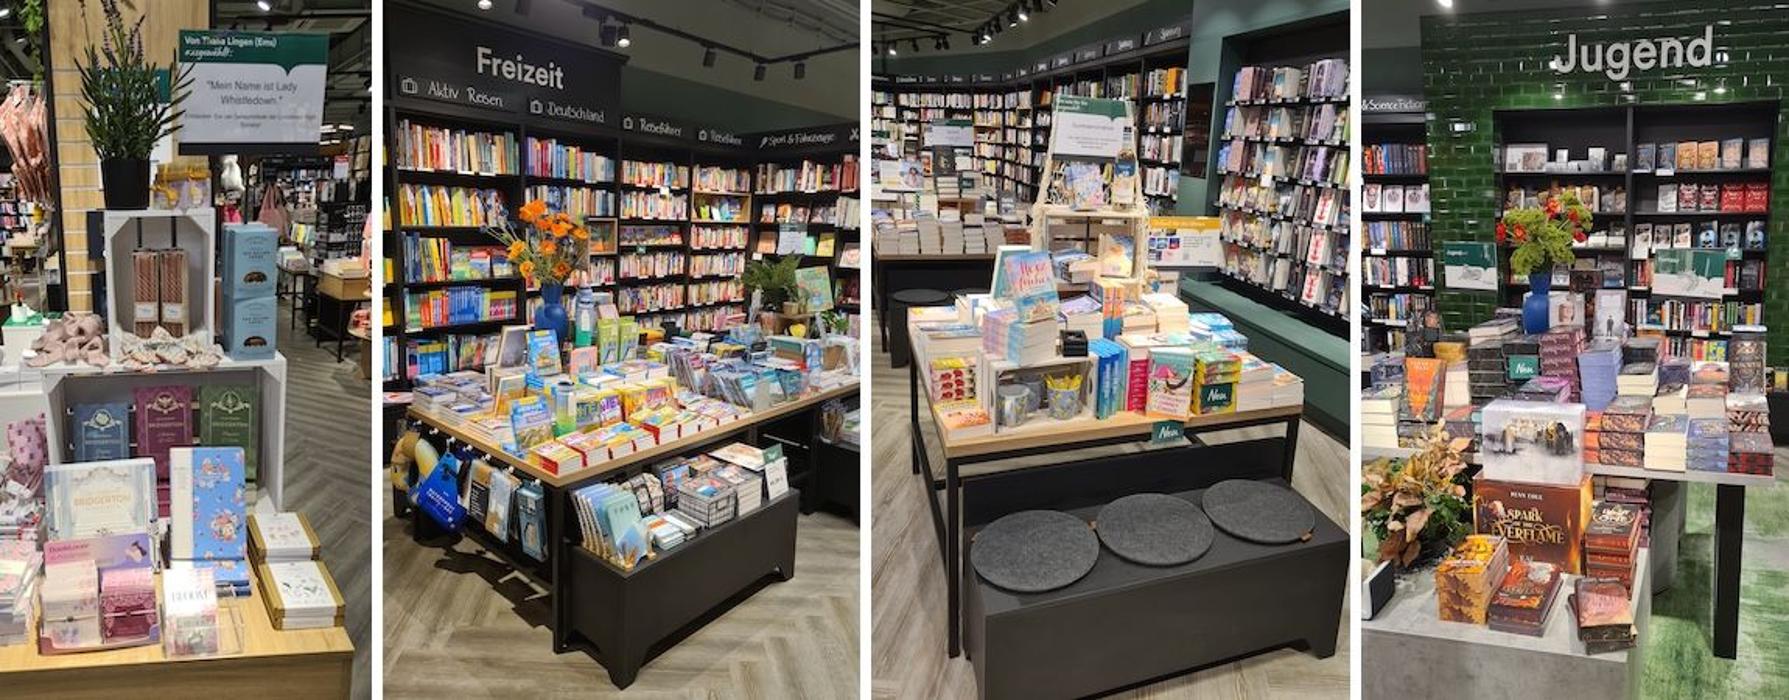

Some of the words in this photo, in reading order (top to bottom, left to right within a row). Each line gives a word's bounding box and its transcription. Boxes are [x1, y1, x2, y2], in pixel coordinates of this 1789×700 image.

[1554, 24, 1714, 81] Jugend
[476, 46, 564, 89] Freizeit
[234, 81, 262, 92] Name
[263, 82, 275, 92] ist
[276, 82, 298, 94] Lady
[427, 80, 460, 99] Aktiv
[466, 86, 504, 108] Reisen
[547, 101, 605, 123] Deutschland
[1368, 99, 1398, 111] Science
[1515, 362, 1534, 374] Neu
[1206, 388, 1227, 402] Neu
[1158, 426, 1180, 439] Neu
[1507, 507, 1544, 522] SPARK
[1491, 524, 1566, 544] EVERFLAME
